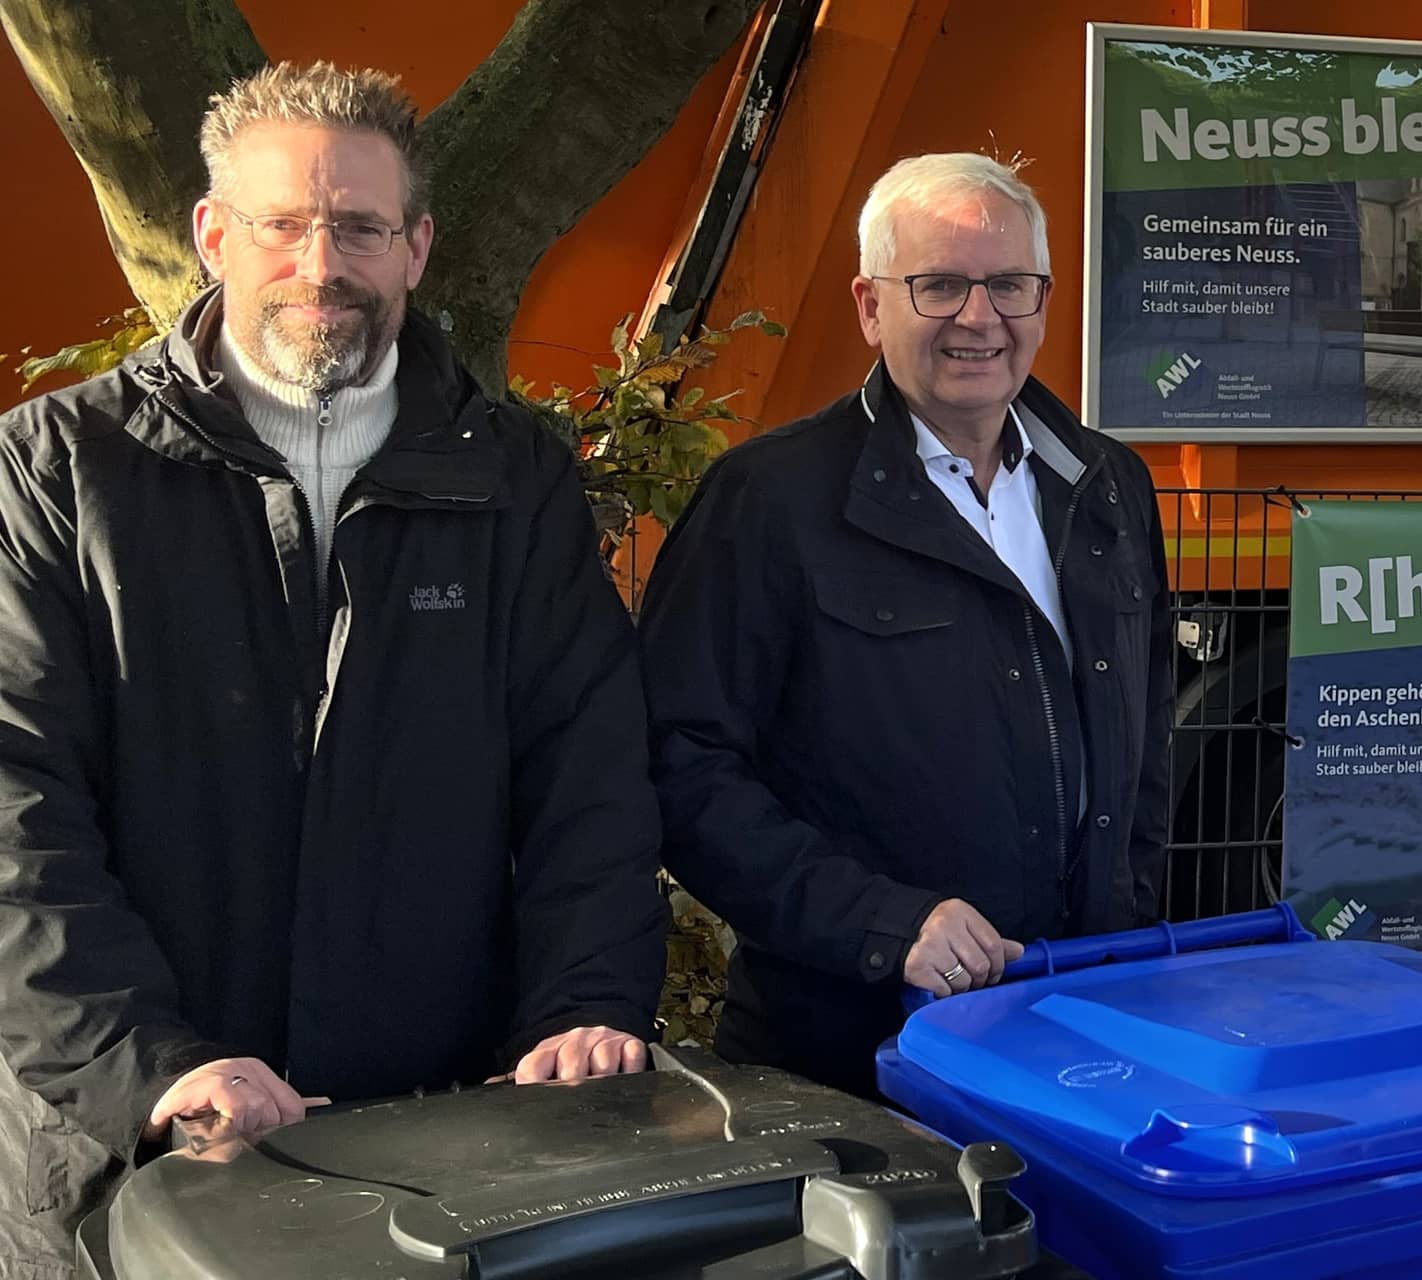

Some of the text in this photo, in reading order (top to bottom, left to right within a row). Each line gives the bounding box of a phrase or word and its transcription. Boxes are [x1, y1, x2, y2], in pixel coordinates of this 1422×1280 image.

[1140, 107, 1331, 162] Neuss
[1143, 214, 1328, 237] Gemeinsam für ein
[1143, 242, 1301, 264] sauberes Neuss.
[1143, 280, 1291, 296] Hilf mit, damit unsere
[1142, 299, 1274, 315] Stadt sauber bleibt!
[1156, 352, 1202, 399] AWL
[408, 585, 440, 598] Jack
[410, 597, 466, 611] Wolfskin
[1319, 685, 1382, 706] Kippen
[1317, 710, 1351, 727] den
[1316, 744, 1341, 758] Hilf
[1343, 744, 1368, 758] mit,
[1370, 743, 1408, 757] damit
[1316, 762, 1350, 776] Stadt
[1352, 761, 1395, 775] sauber
[1325, 899, 1367, 941] AWL
